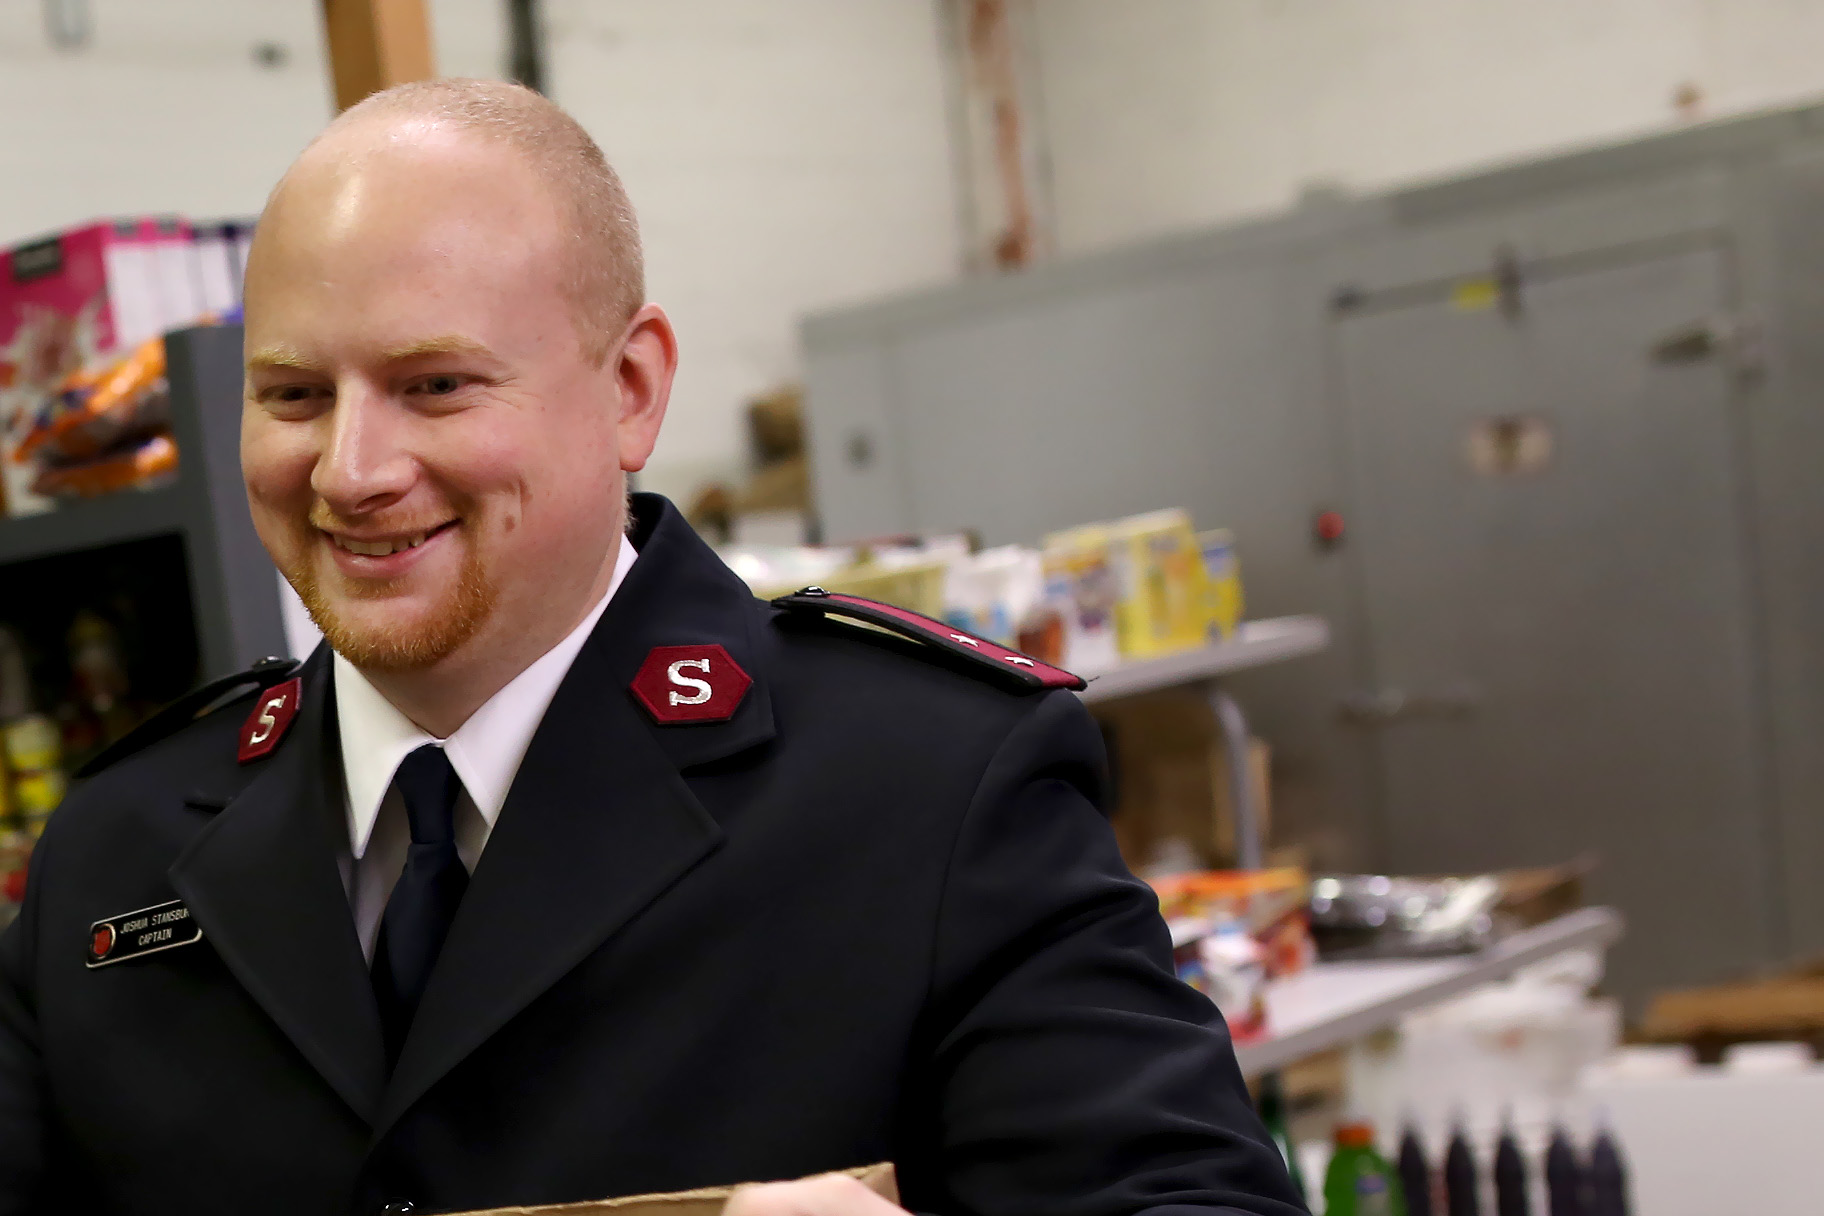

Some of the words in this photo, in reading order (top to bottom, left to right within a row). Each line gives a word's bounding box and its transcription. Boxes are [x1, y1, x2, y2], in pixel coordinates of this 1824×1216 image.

[667, 658, 712, 706] S
[249, 694, 287, 746] S
[120, 917, 149, 934] JOSHUA
[138, 928, 173, 946] CAPTAIN
